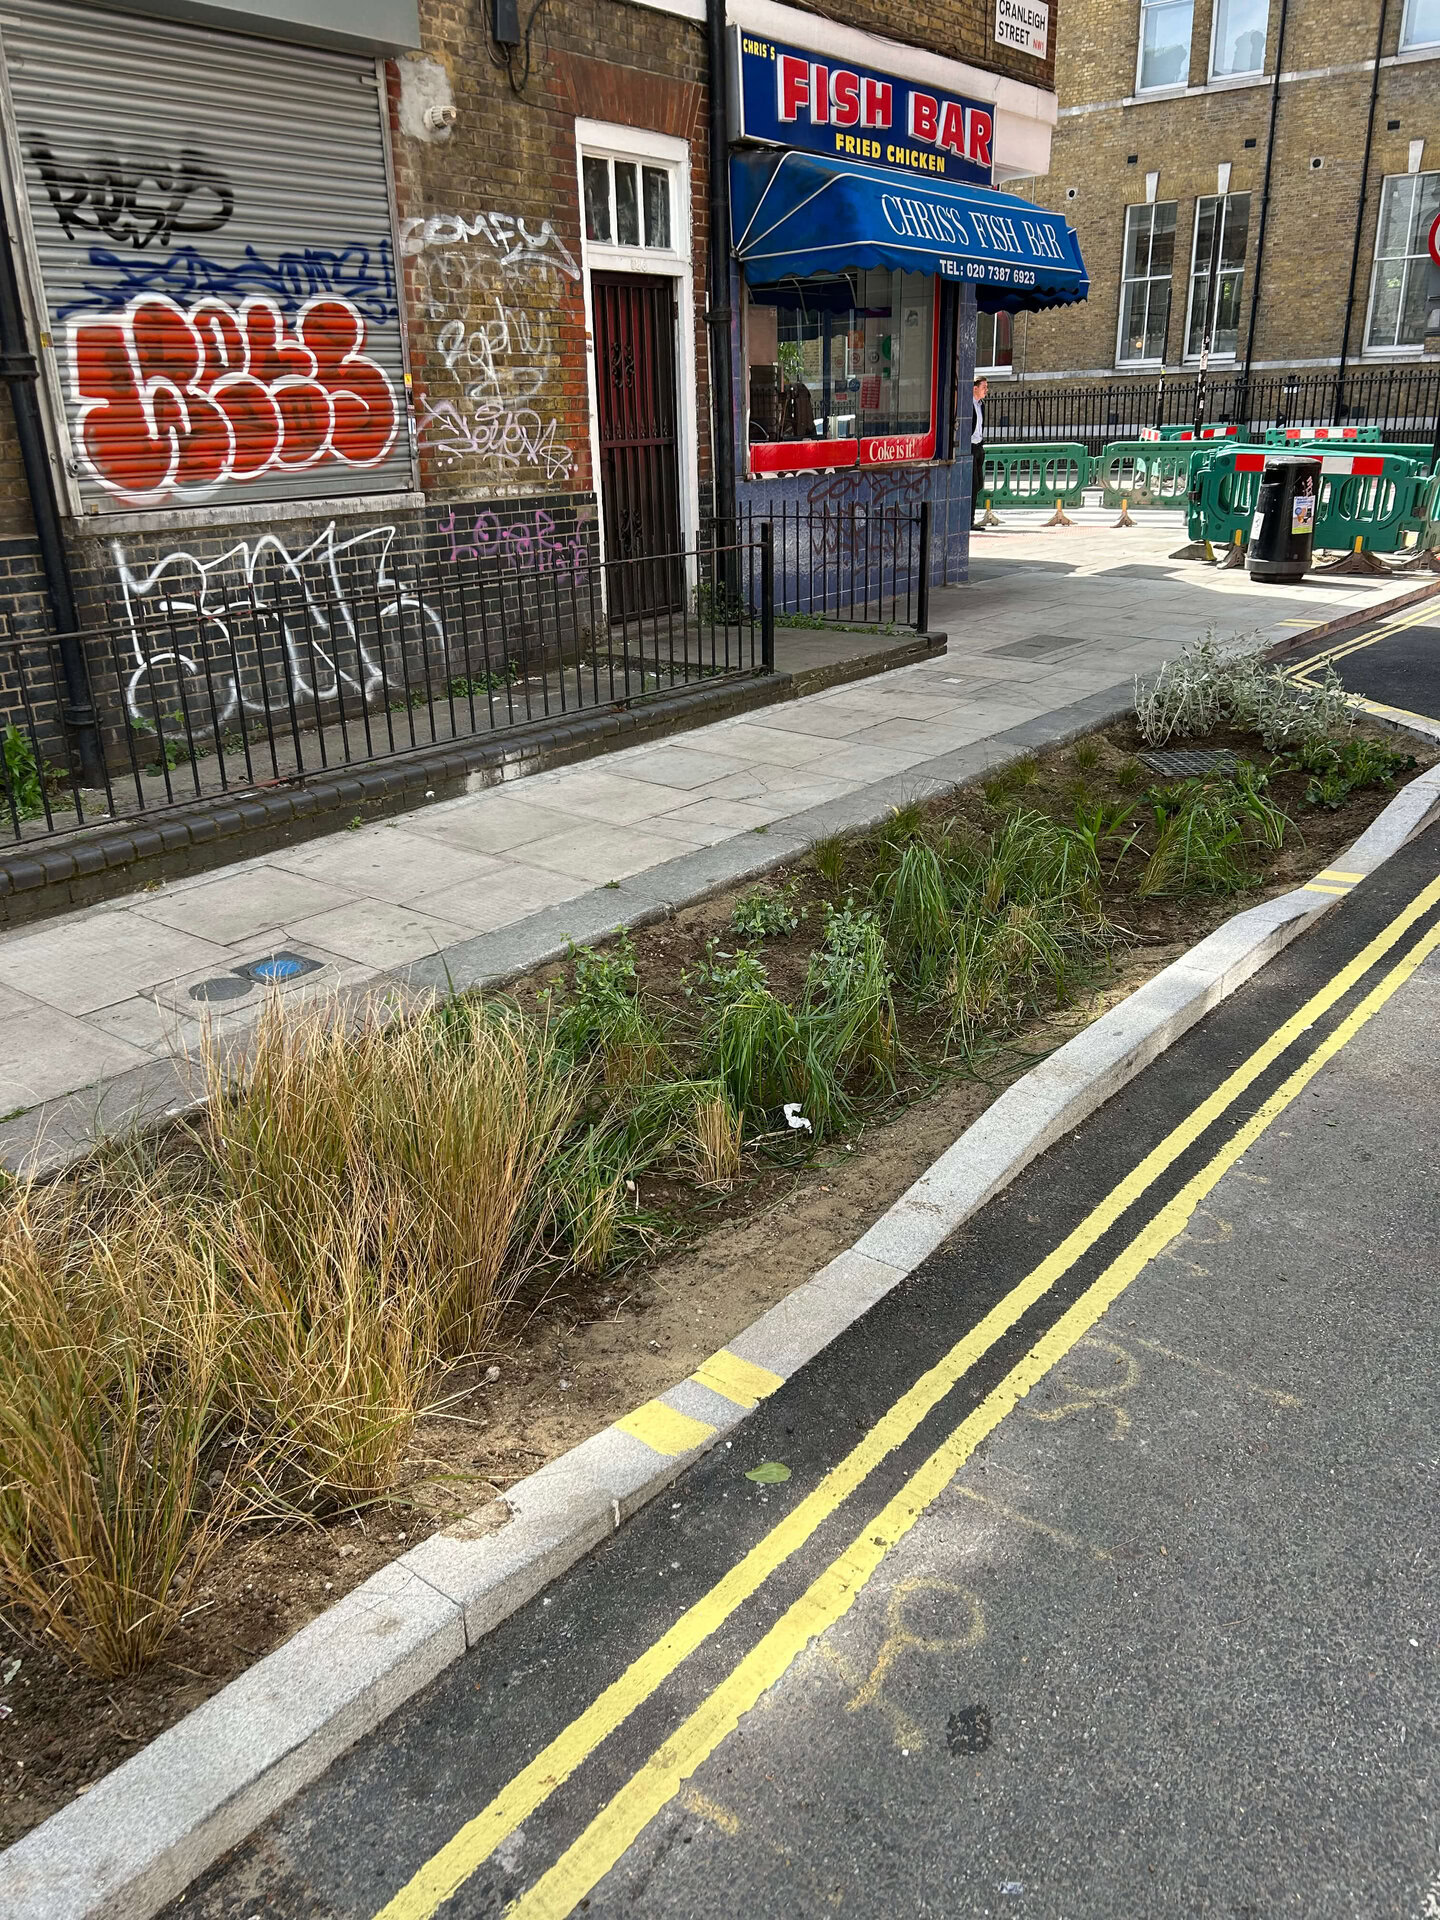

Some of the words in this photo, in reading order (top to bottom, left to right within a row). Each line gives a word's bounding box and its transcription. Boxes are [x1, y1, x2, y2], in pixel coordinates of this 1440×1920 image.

[999, 0, 1046, 31] CRANLEIGH
[998, 20, 1030, 46] STREET
[743, 38, 776, 61] CHRIS'S
[777, 53, 893, 130] FISH
[908, 90, 992, 168] BAR
[835, 132, 881, 159] FRIED
[886, 144, 945, 173] CHICKEN
[881, 193, 970, 246] CHRIS'S
[967, 211, 1024, 254] FISH
[1021, 220, 1065, 260] BAR
[939, 259, 964, 276] TEL:
[966, 262, 985, 279] 020
[987, 265, 1011, 282] 7387
[1013, 269, 1035, 285] 6923
[869, 440, 895, 461] Coke
[896, 439, 904, 459] is
[905, 438, 915, 458] it!
